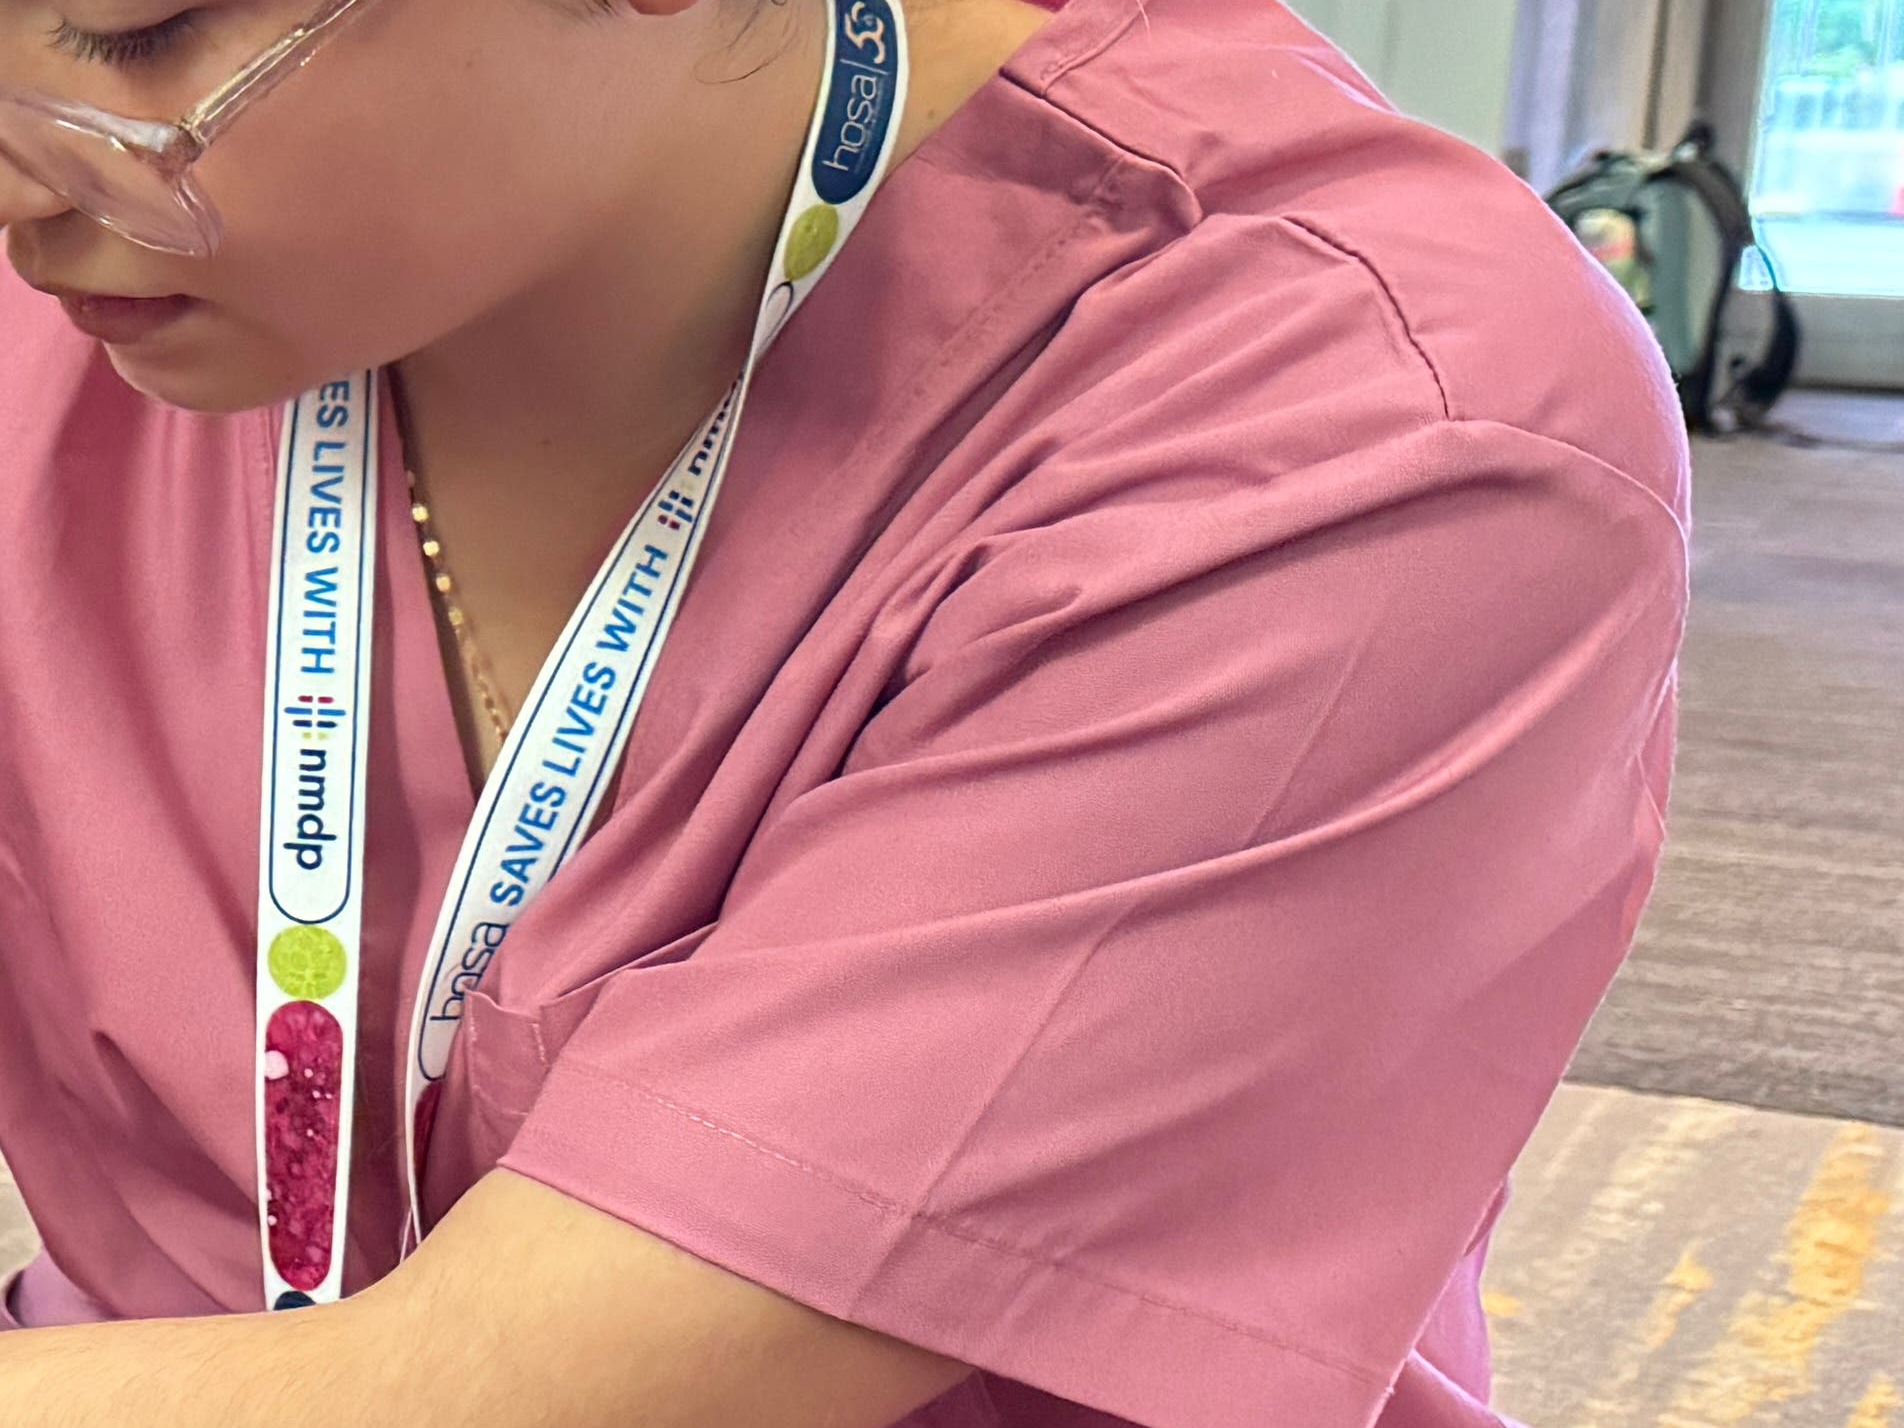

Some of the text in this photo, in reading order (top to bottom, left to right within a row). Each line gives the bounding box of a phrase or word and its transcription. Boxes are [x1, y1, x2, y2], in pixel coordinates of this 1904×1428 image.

[822, 74, 878, 171] hosa
[306, 441, 347, 554] LIVES
[301, 567, 338, 675] WITH
[489, 780, 567, 908] SAVES
[542, 661, 617, 778] LIVES
[596, 544, 668, 652] WITH
[283, 748, 337, 870] nmdp
